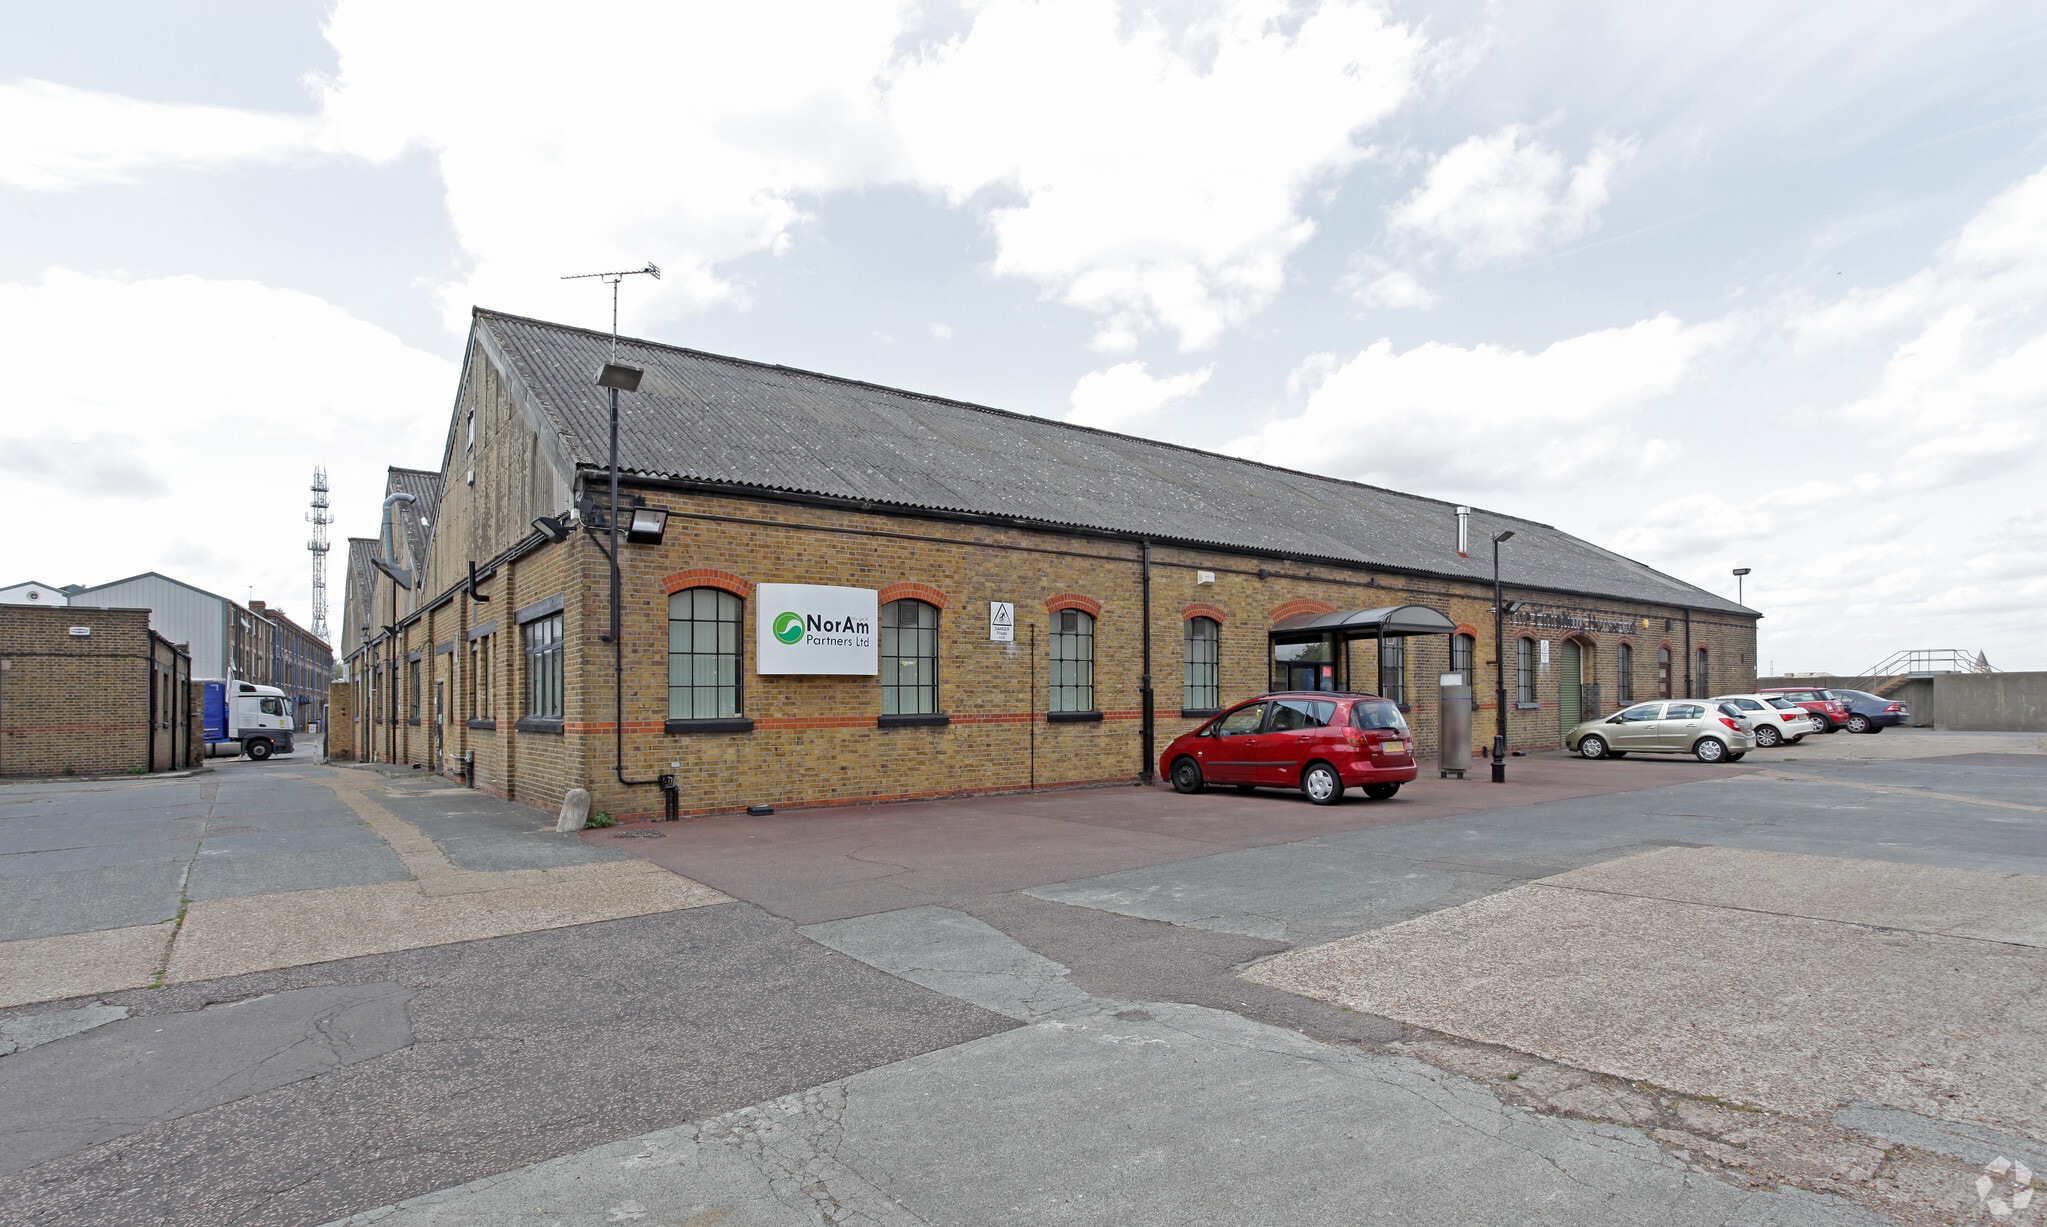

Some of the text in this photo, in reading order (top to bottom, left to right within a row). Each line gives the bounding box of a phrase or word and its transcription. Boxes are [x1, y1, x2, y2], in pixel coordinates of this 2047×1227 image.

[807, 614, 869, 634] NorAm
[807, 635, 869, 647] Partners Ltd
